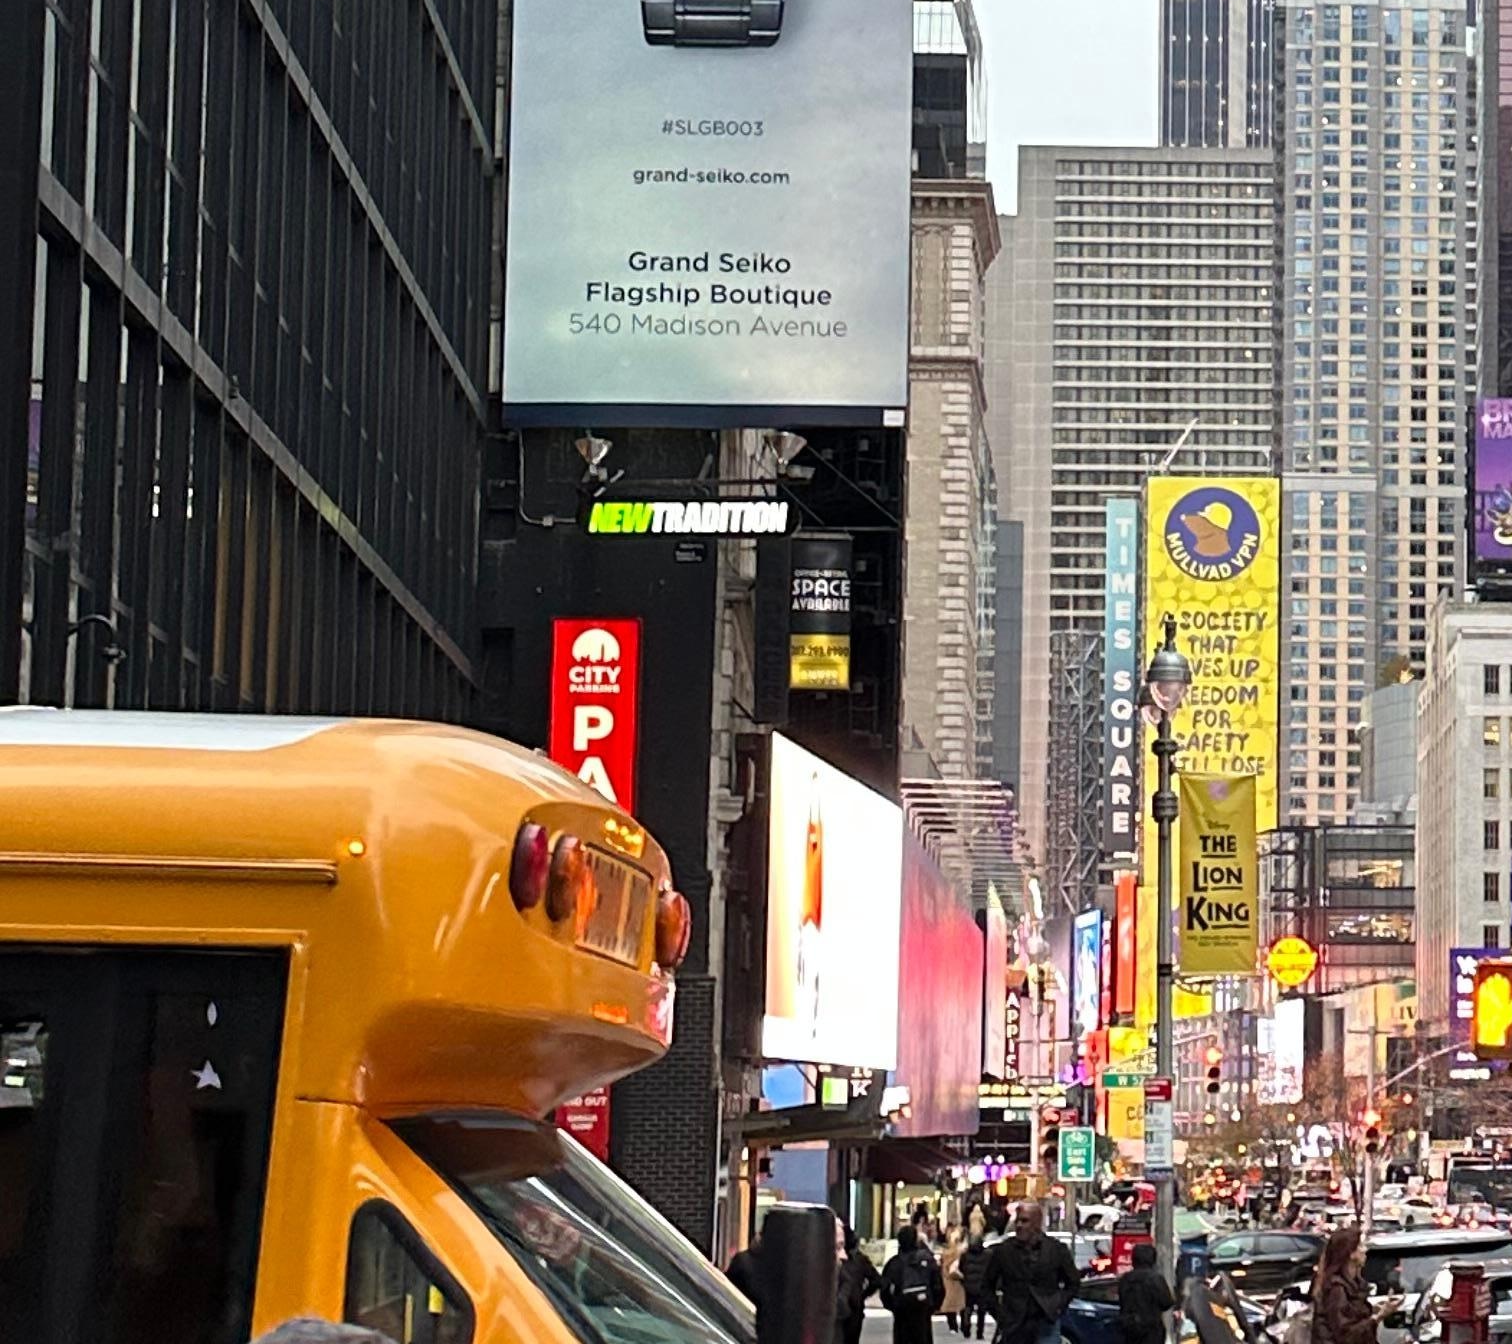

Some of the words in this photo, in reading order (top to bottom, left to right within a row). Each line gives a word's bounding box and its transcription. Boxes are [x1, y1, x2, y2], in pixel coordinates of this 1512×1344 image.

[662, 120, 764, 136] #SLGB003
[633, 168, 790, 185] grand-seiko.com
[629, 252, 709, 274] Grand
[719, 254, 791, 274] Seiko
[586, 282, 700, 307] Flagship
[711, 285, 832, 308] Boutique
[569, 313, 621, 335] 540
[632, 314, 740, 336] Madison
[751, 316, 848, 337] Avenue
[1167, 532, 1232, 580] MULLVAD
[1231, 533, 1258, 568] VPN
[792, 579, 850, 597] SPACE
[1179, 610, 1268, 631] SOCIETY
[1188, 635, 1237, 655] THAT
[569, 666, 621, 683] CITY
[1190, 658, 1223, 677] VES
[1230, 658, 1259, 678] UP
[1185, 685, 1258, 706] EEDOM
[1192, 709, 1231, 729] FOR
[1199, 834, 1237, 853] THE
[1192, 861, 1243, 892] LION
[1186, 897, 1250, 931] KING
